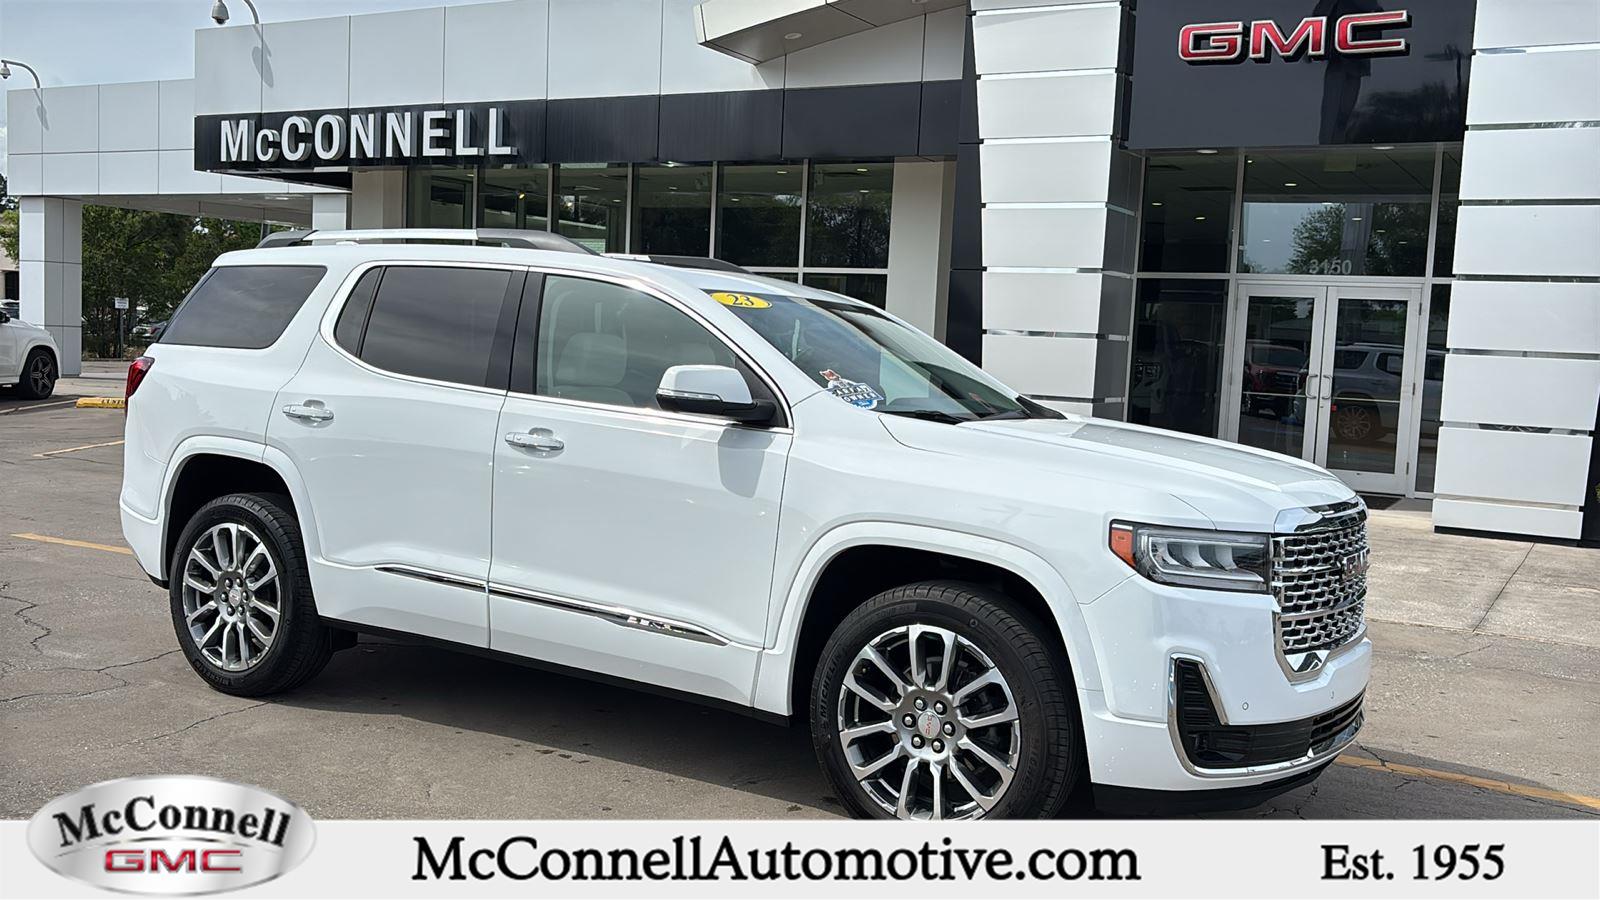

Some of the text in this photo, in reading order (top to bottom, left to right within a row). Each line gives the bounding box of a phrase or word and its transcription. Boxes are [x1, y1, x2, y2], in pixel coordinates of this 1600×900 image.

[1179, 10, 1407, 61] GMC
[220, 107, 516, 162] McCONNELL
[1309, 259, 1352, 275] 3150
[726, 293, 754, 306] 23
